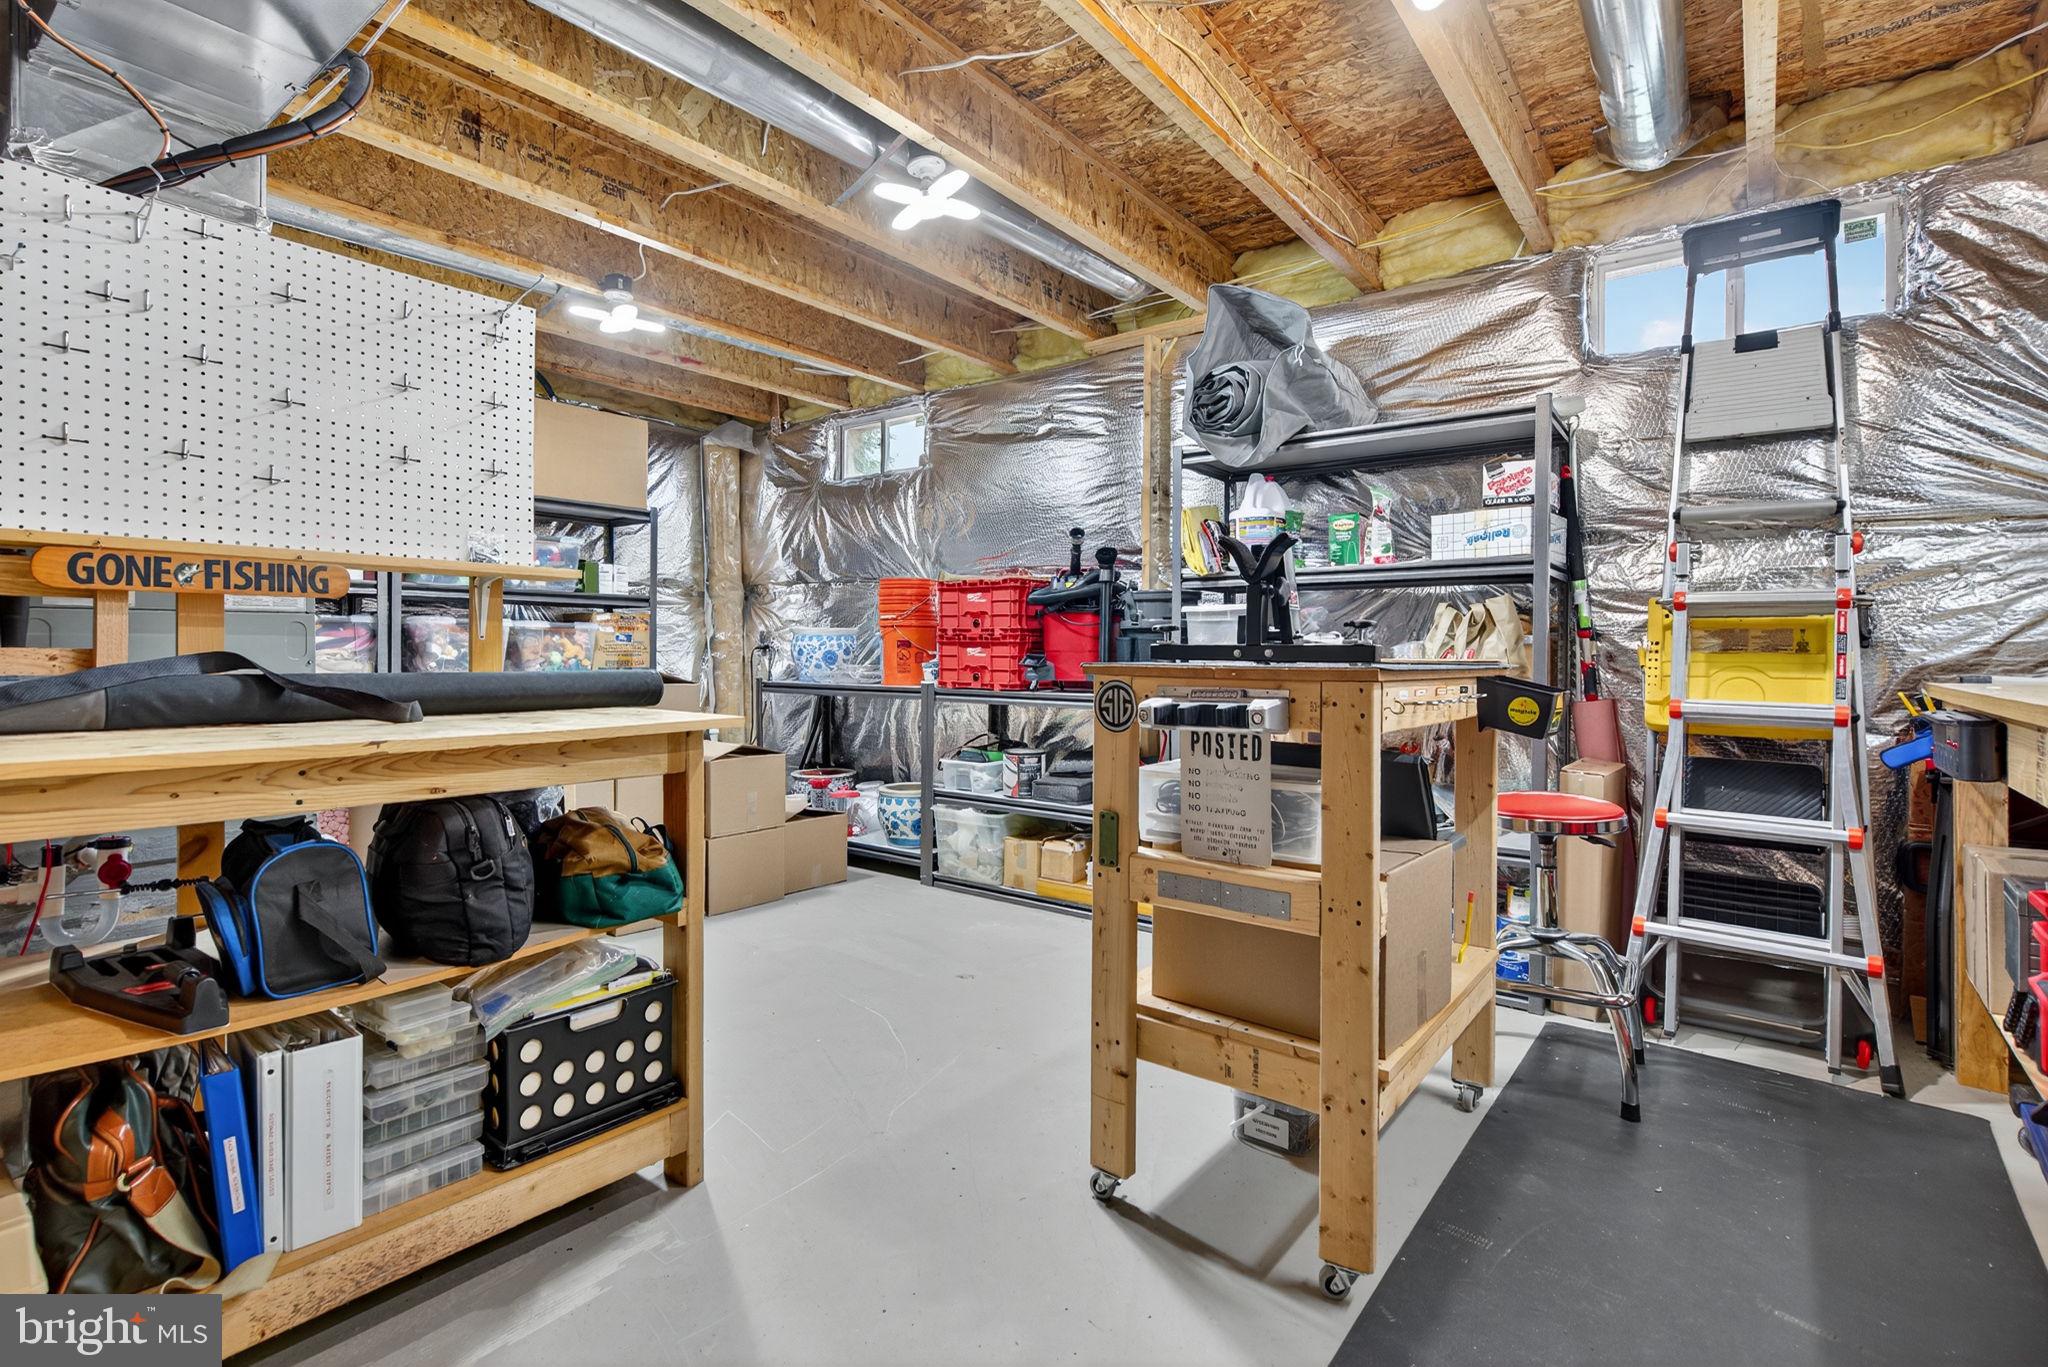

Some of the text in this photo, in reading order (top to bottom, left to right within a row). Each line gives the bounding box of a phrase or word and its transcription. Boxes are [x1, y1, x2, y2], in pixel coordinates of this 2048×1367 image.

[67, 552, 329, 594] GONE FISHING
[1101, 688, 1131, 724] SIG
[1191, 730, 1262, 761] POSTED
[1188, 767, 1201, 775] NO
[1188, 804, 1201, 812] NO
